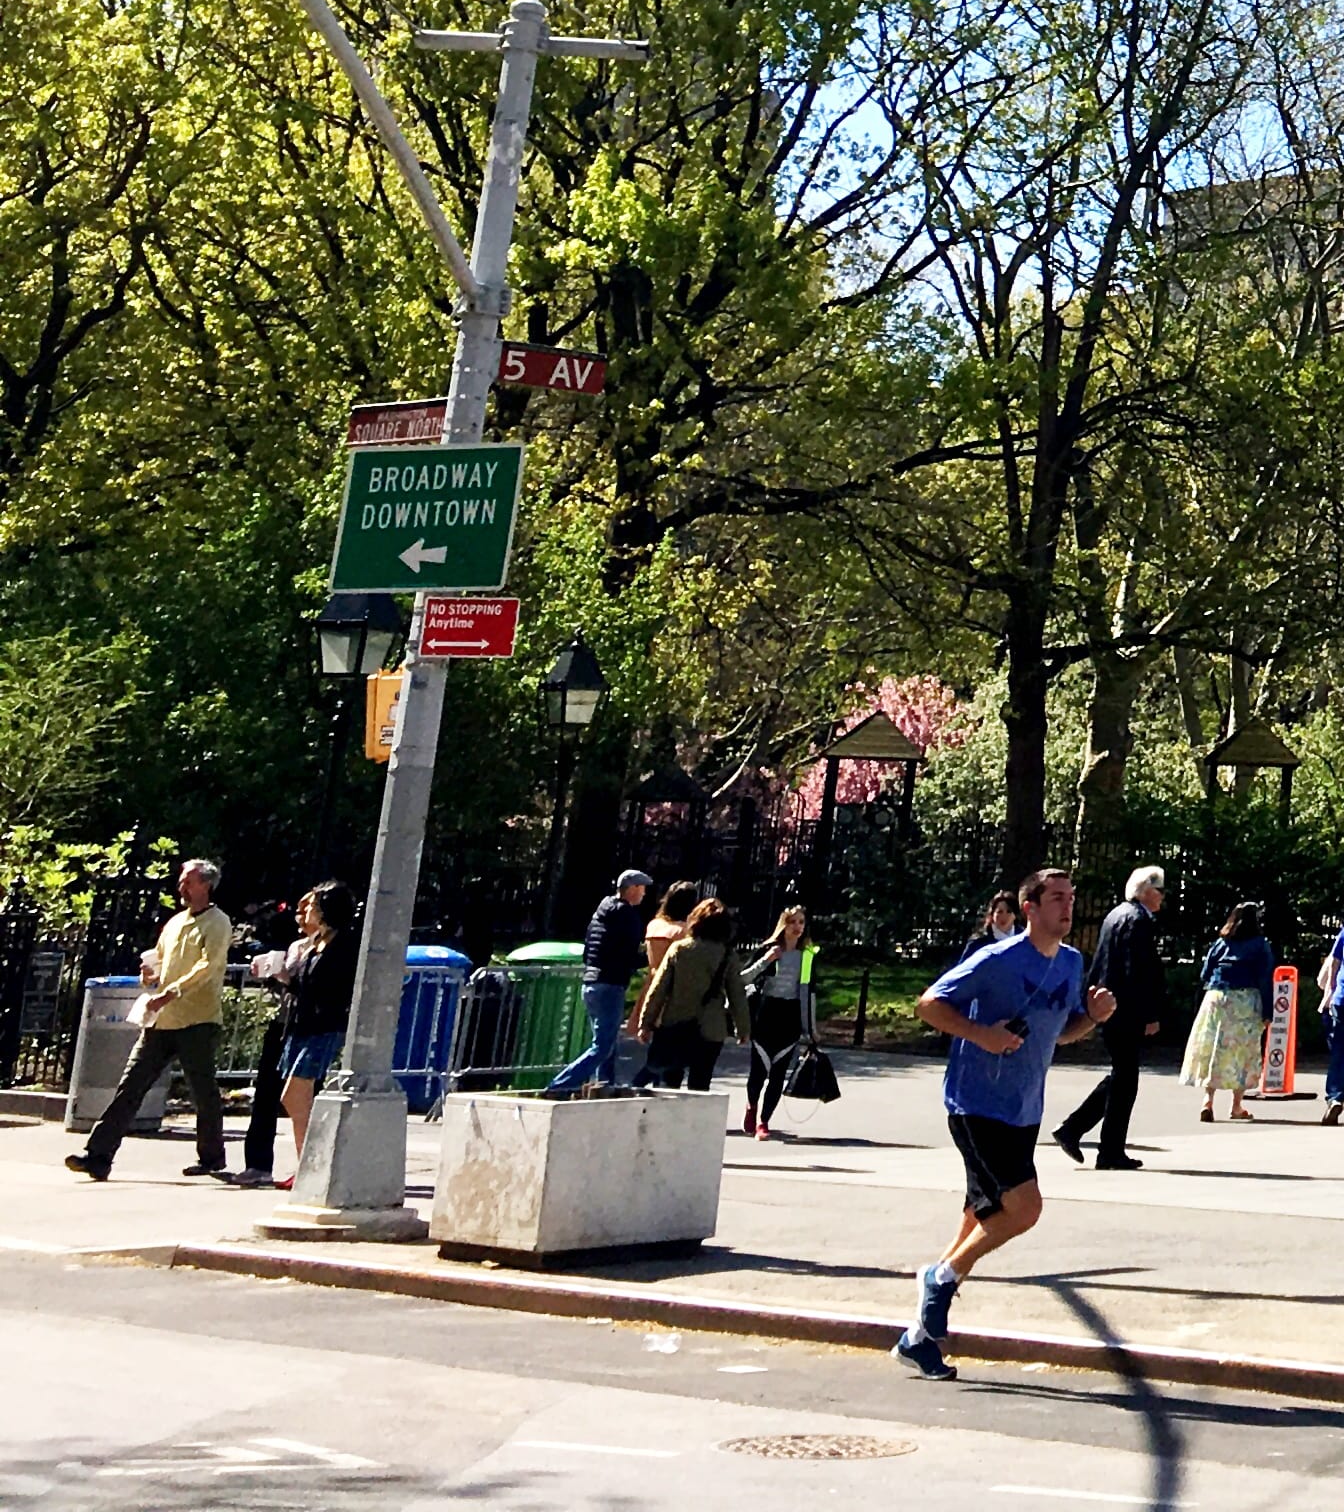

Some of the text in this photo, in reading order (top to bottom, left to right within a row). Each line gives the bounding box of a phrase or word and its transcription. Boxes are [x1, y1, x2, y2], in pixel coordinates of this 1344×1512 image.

[504, 350, 594, 390] 5 AV
[355, 416, 445, 442] SQUARE NORTH
[368, 461, 500, 494] BROADWAY
[361, 499, 497, 530] DOWNTOWN
[429, 617, 474, 630] Anytime
[430, 603, 502, 616] NO STOPPING
